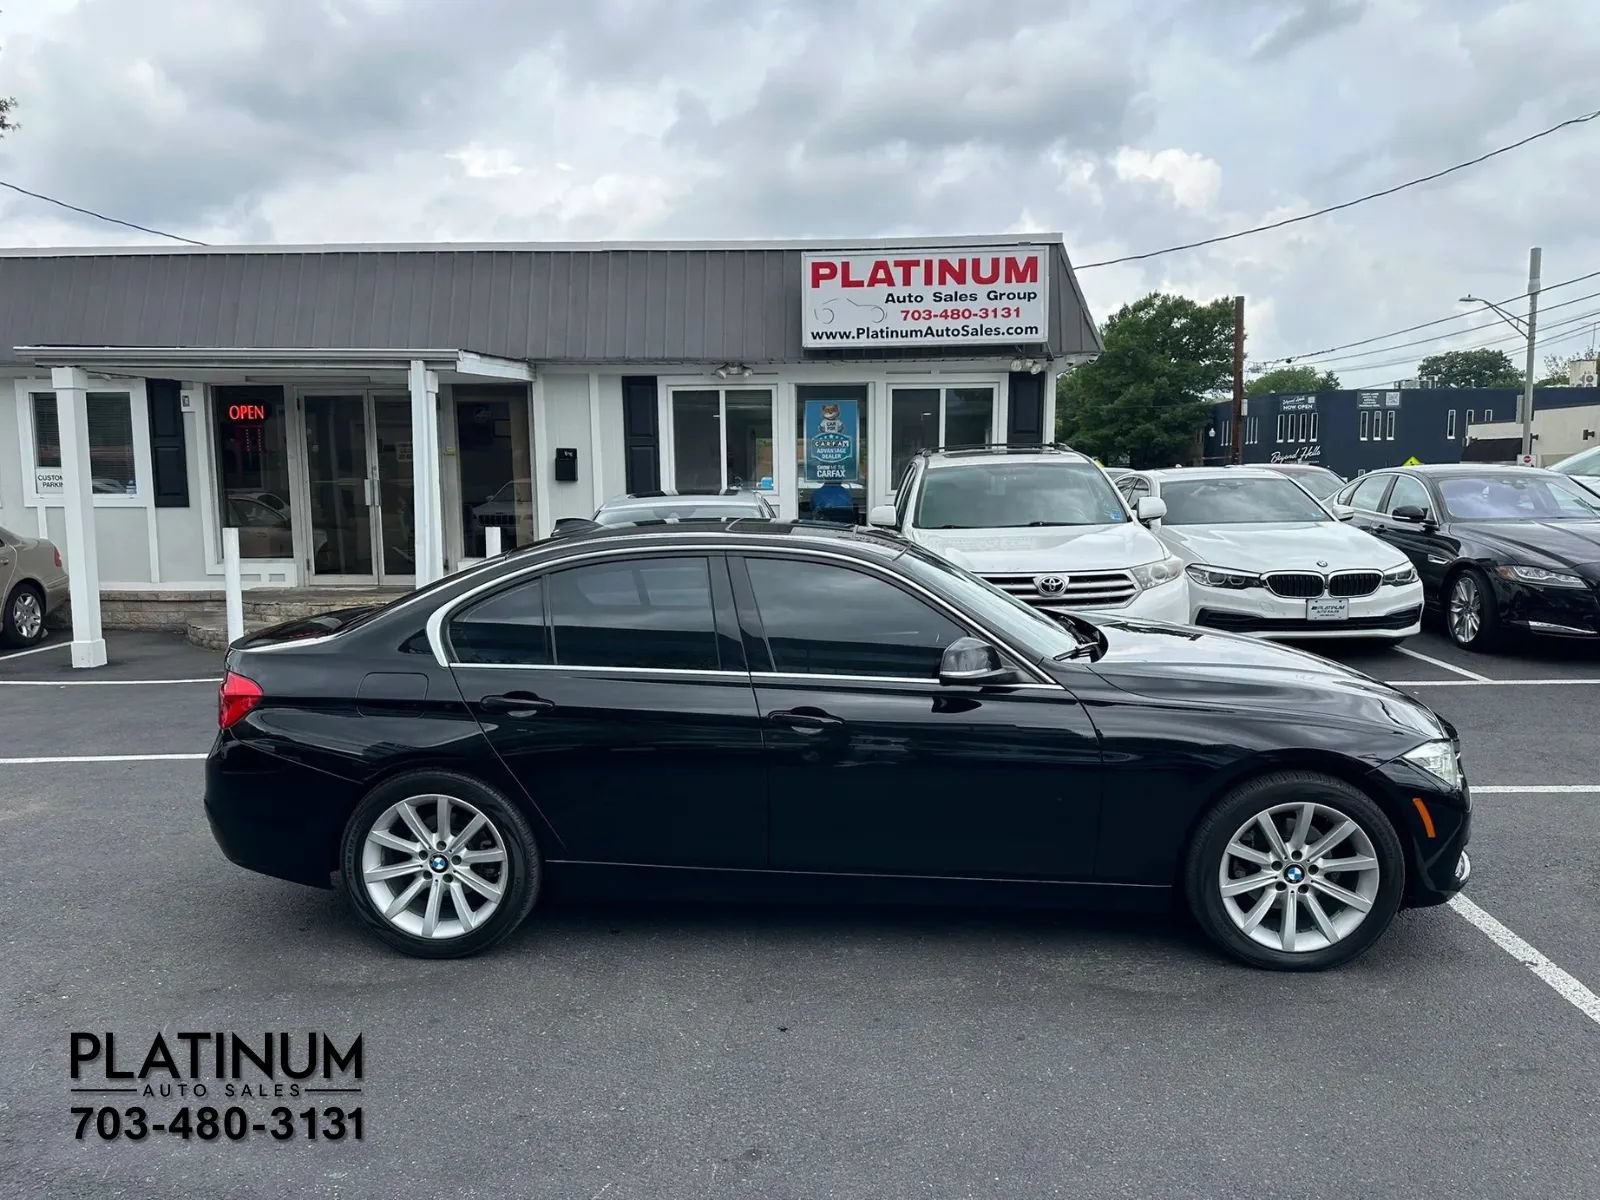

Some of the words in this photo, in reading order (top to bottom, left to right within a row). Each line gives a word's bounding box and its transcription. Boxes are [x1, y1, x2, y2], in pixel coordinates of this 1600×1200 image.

[811, 256, 1039, 288] PLATINUM
[885, 292, 924, 304] Auto
[932, 291, 978, 303] Sales
[986, 289, 1038, 303] Group
[900, 307, 1021, 321] 703-480-3131
[811, 324, 1039, 341] www.PlatinumAutoSales.com
[229, 405, 264, 420] OPEN
[816, 470, 846, 478] CARFAX
